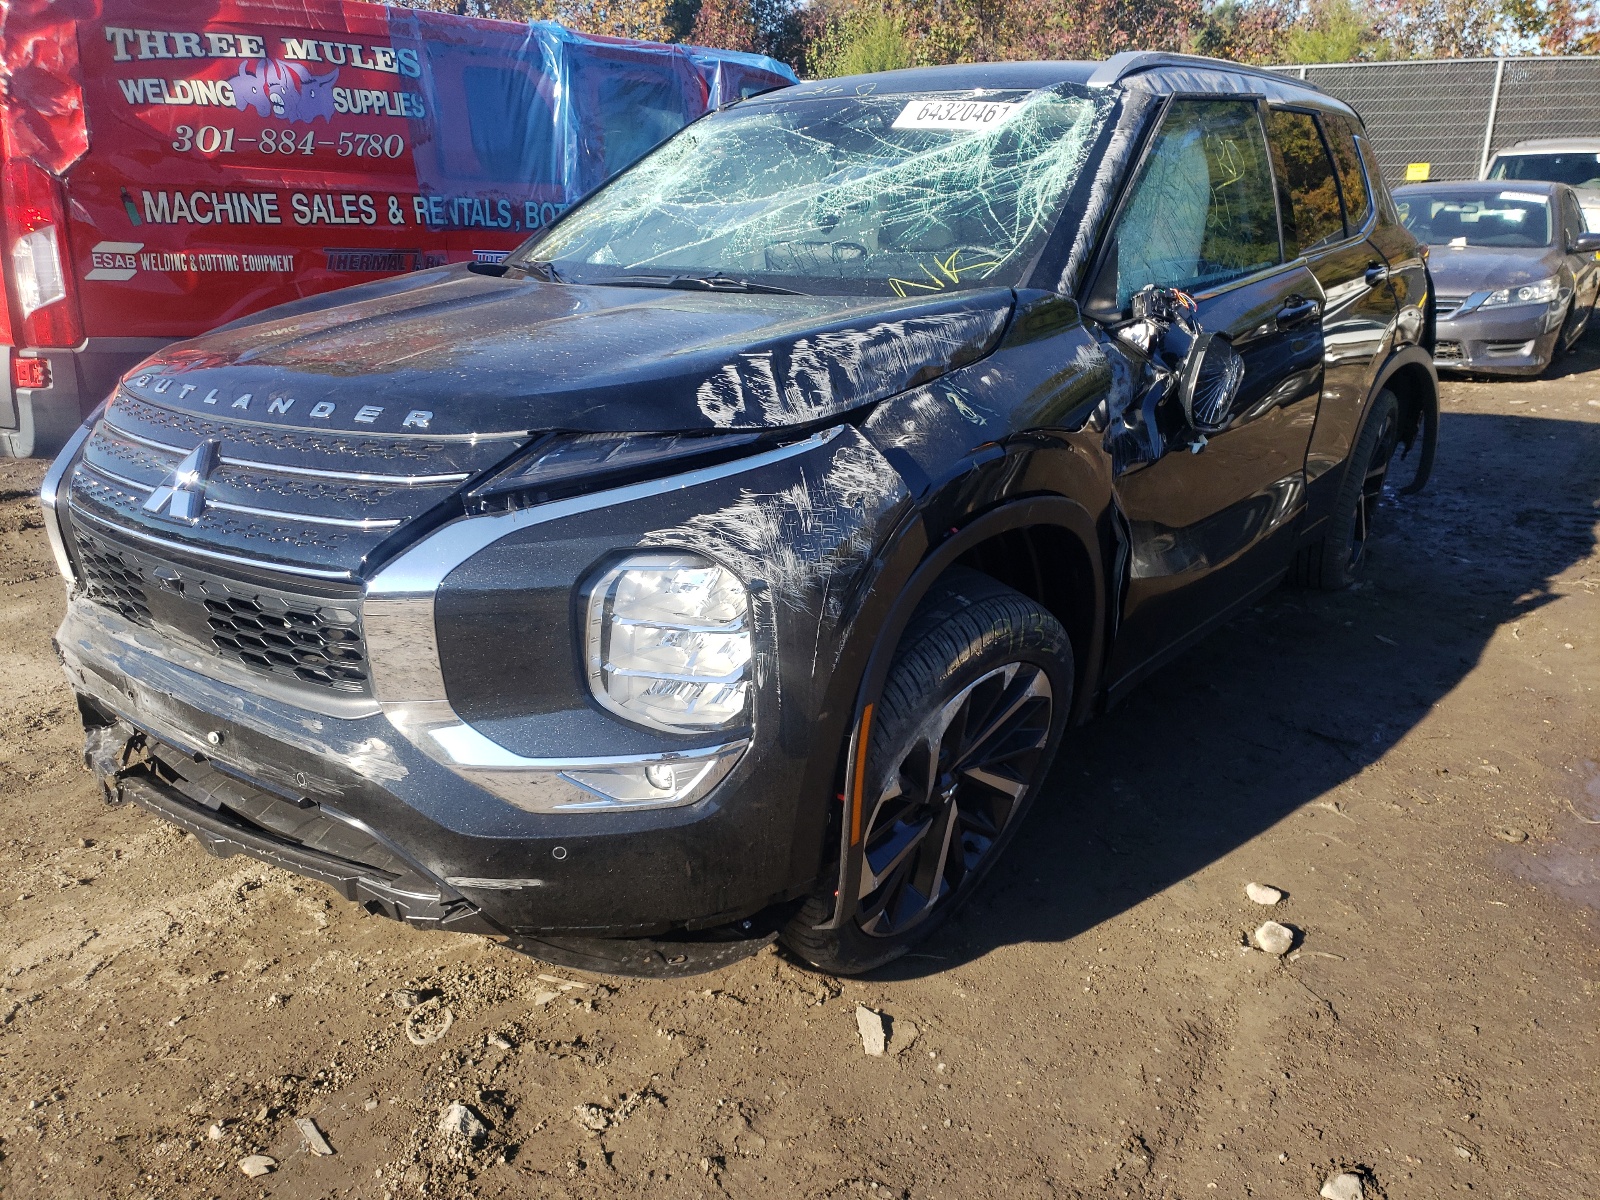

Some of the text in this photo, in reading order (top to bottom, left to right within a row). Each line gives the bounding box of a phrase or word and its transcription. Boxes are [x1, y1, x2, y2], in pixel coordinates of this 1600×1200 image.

[105, 27, 421, 78] THREE MULES
[118, 78, 425, 118] WELDING SUPPLIES
[172, 125, 404, 159] 301-884-5780
[142, 190, 281, 224] MACHINE
[292, 195, 375, 225] SALES
[388, 195, 405, 225] &
[525, 201, 581, 229] BOT
[92, 253, 136, 268] ESAB
[140, 253, 187, 272] WELDING
[199, 255, 239, 272] CUTTING
[242, 255, 294, 272] EQUIPMENT
[323, 248, 407, 271] THERMAL
[136, 374, 434, 428] OUTLANDER
